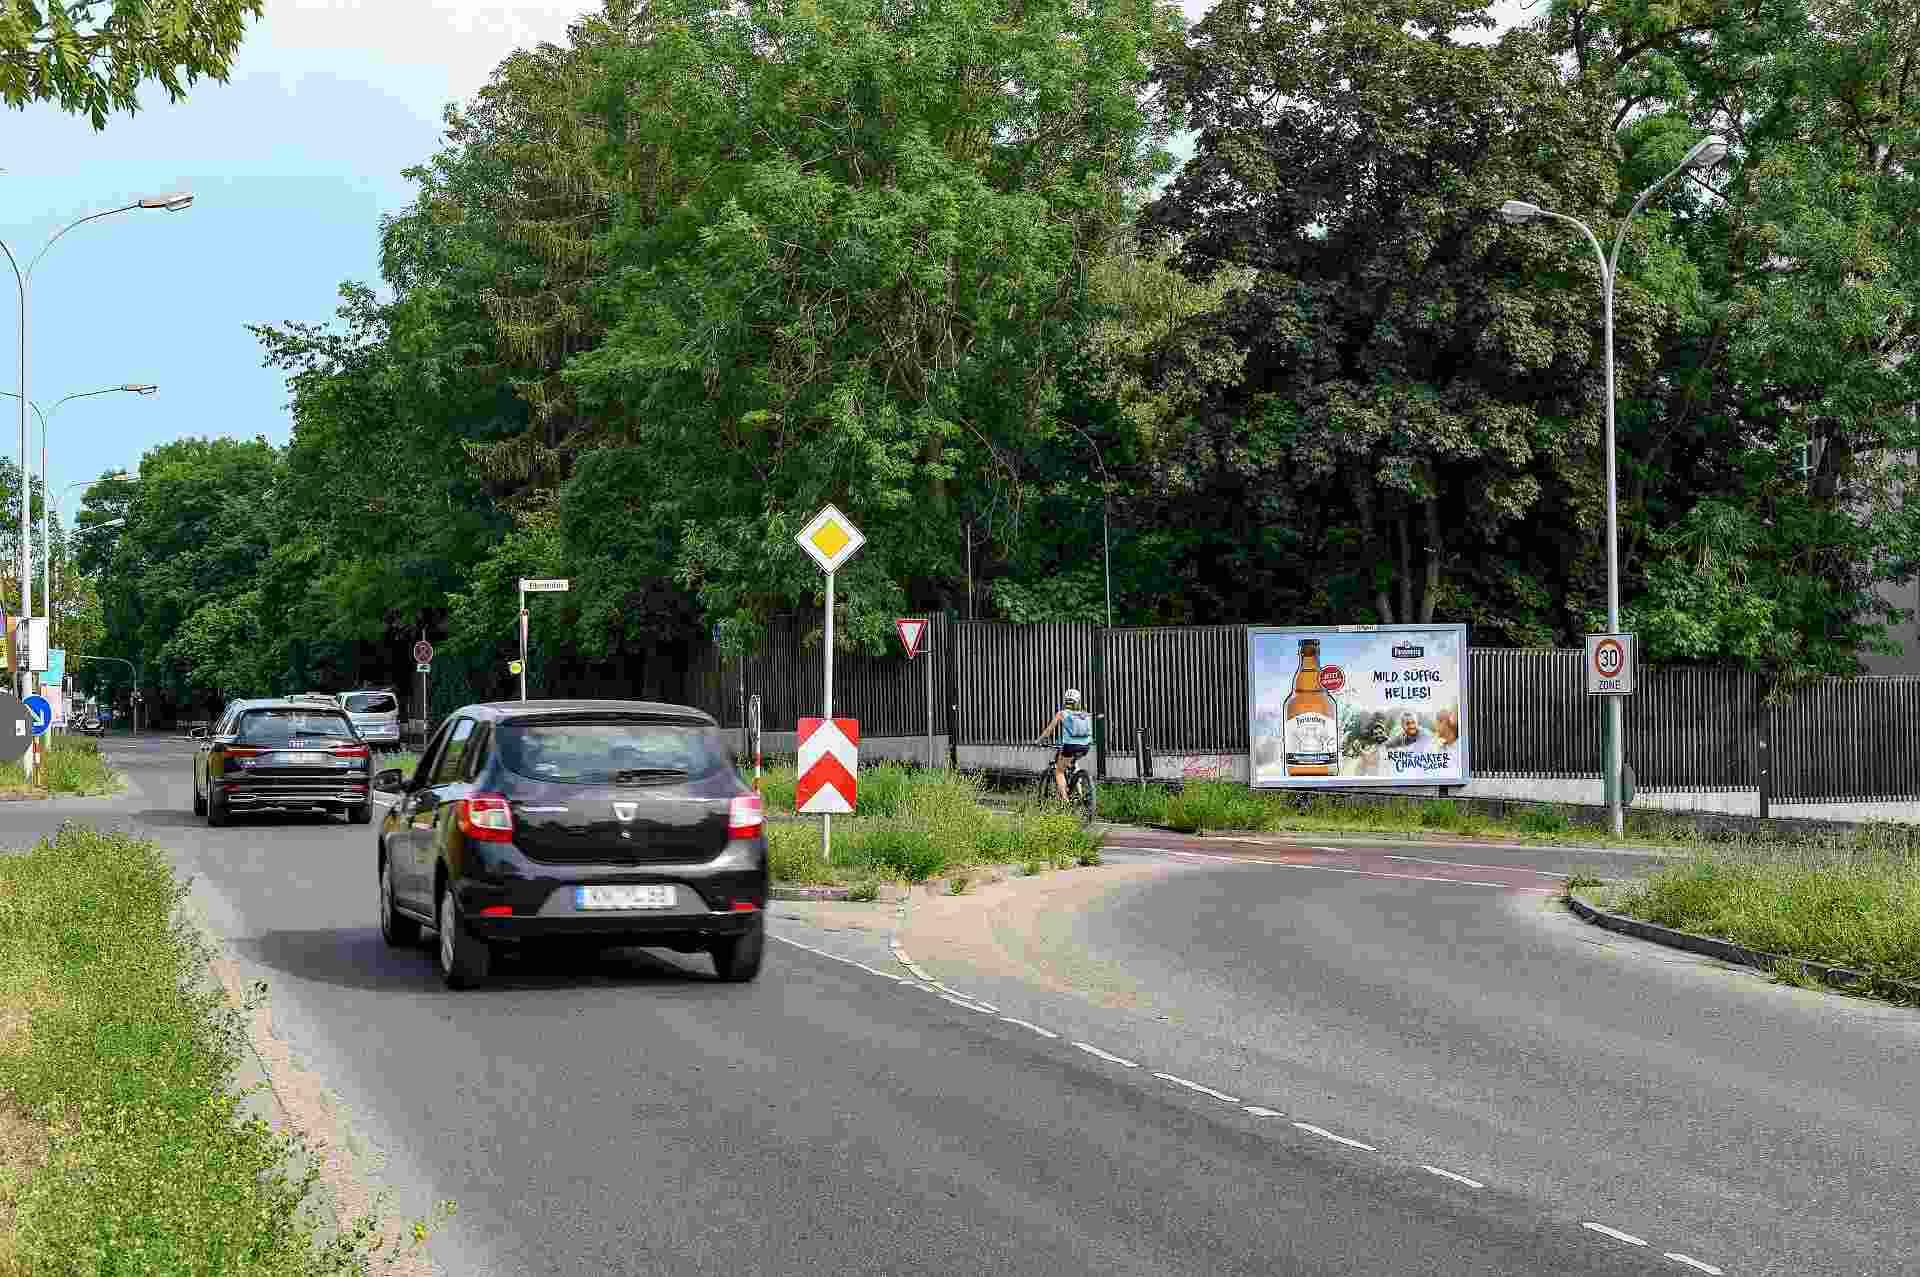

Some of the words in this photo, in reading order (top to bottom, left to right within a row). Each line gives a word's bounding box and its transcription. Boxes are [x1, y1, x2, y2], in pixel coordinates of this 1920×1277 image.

[1600, 649, 1617, 667] 30
[1600, 680, 1621, 689] ZONE
[1384, 687, 1432, 699] HELLES!
